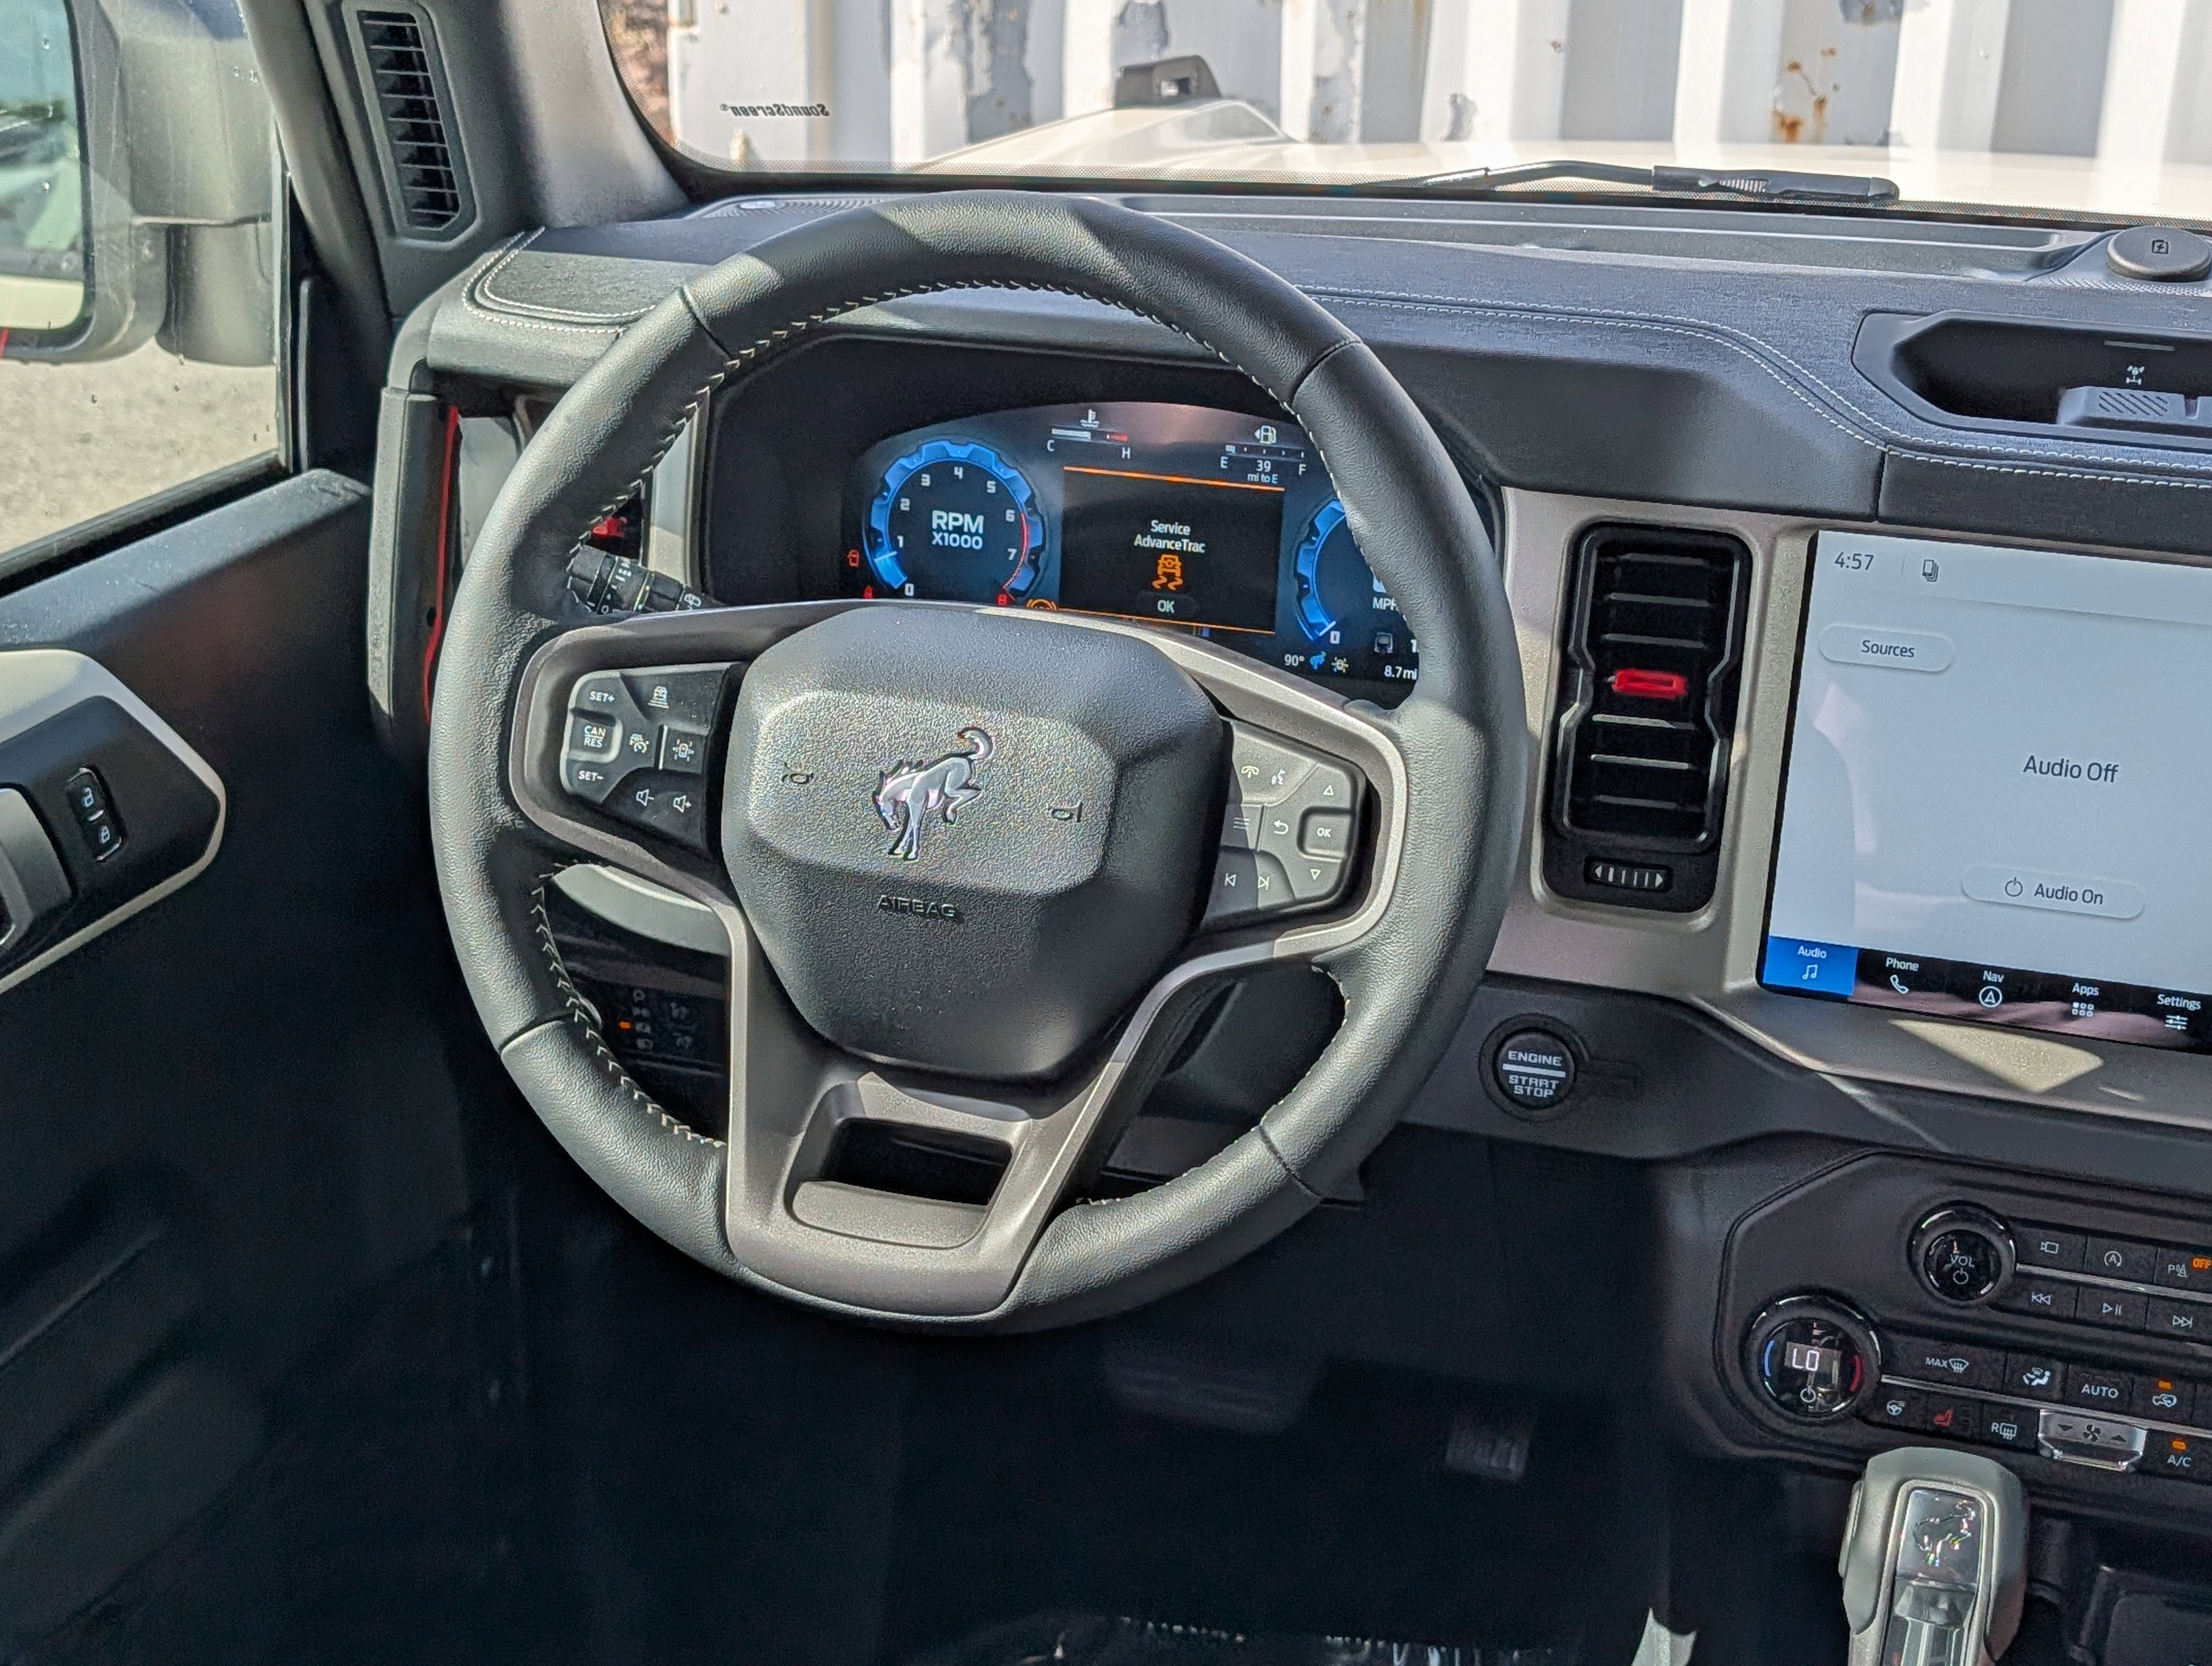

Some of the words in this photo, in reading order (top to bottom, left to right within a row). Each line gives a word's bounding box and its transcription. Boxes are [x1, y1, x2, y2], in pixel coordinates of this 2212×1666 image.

[1047, 440, 1054, 452] C
[1122, 448, 1130, 459] H
[1220, 456, 1228, 469] E
[1256, 460, 1271, 472] 39
[954, 467, 963, 479] 4
[1298, 464, 1307, 476] F
[921, 474, 930, 486] 3
[1248, 473, 1259, 482] mi
[1261, 473, 1270, 483] to
[1272, 474, 1278, 484] E
[987, 480, 996, 493] 5
[901, 498, 910, 511] 2
[932, 510, 984, 534] RPM
[1006, 509, 1015, 522] 6
[1150, 520, 1191, 535] Service
[897, 535, 904, 548] 1
[932, 531, 983, 549] X1000
[1134, 534, 1206, 553] AdvanceTrac
[1007, 549, 1017, 560] 7
[1834, 552, 1874, 571] 4:57
[905, 583, 914, 596] 0
[1158, 600, 1175, 614] OK
[1330, 631, 1341, 644] 0
[1861, 639, 1915, 658] Sources
[1384, 665, 1403, 678] 8.7
[584, 725, 606, 736] CAN
[584, 737, 603, 748] RES
[2023, 755, 2082, 779] Audio
[2087, 762, 2119, 783] Off
[1316, 827, 1332, 838] OK
[2034, 883, 2079, 902] Audio
[2082, 889, 2104, 905] On
[876, 895, 956, 918] AIRBAG
[1797, 945, 1827, 959] Audio
[1886, 957, 1919, 972] Phone
[1983, 970, 2005, 984] Nav
[2072, 983, 2099, 996] Apps
[2157, 994, 2201, 1011] Settings
[1508, 1050, 1562, 1067] ENGINE
[1508, 1074, 1559, 1090] START
[1513, 1085, 1554, 1098] STOP
[1950, 1254, 1975, 1268] VOL
[2192, 1258, 2211, 1270] OFF
[1925, 1357, 1948, 1368] MAX
[2081, 1383, 2119, 1399] AUTO
[2166, 1454, 2192, 1468] A/C
